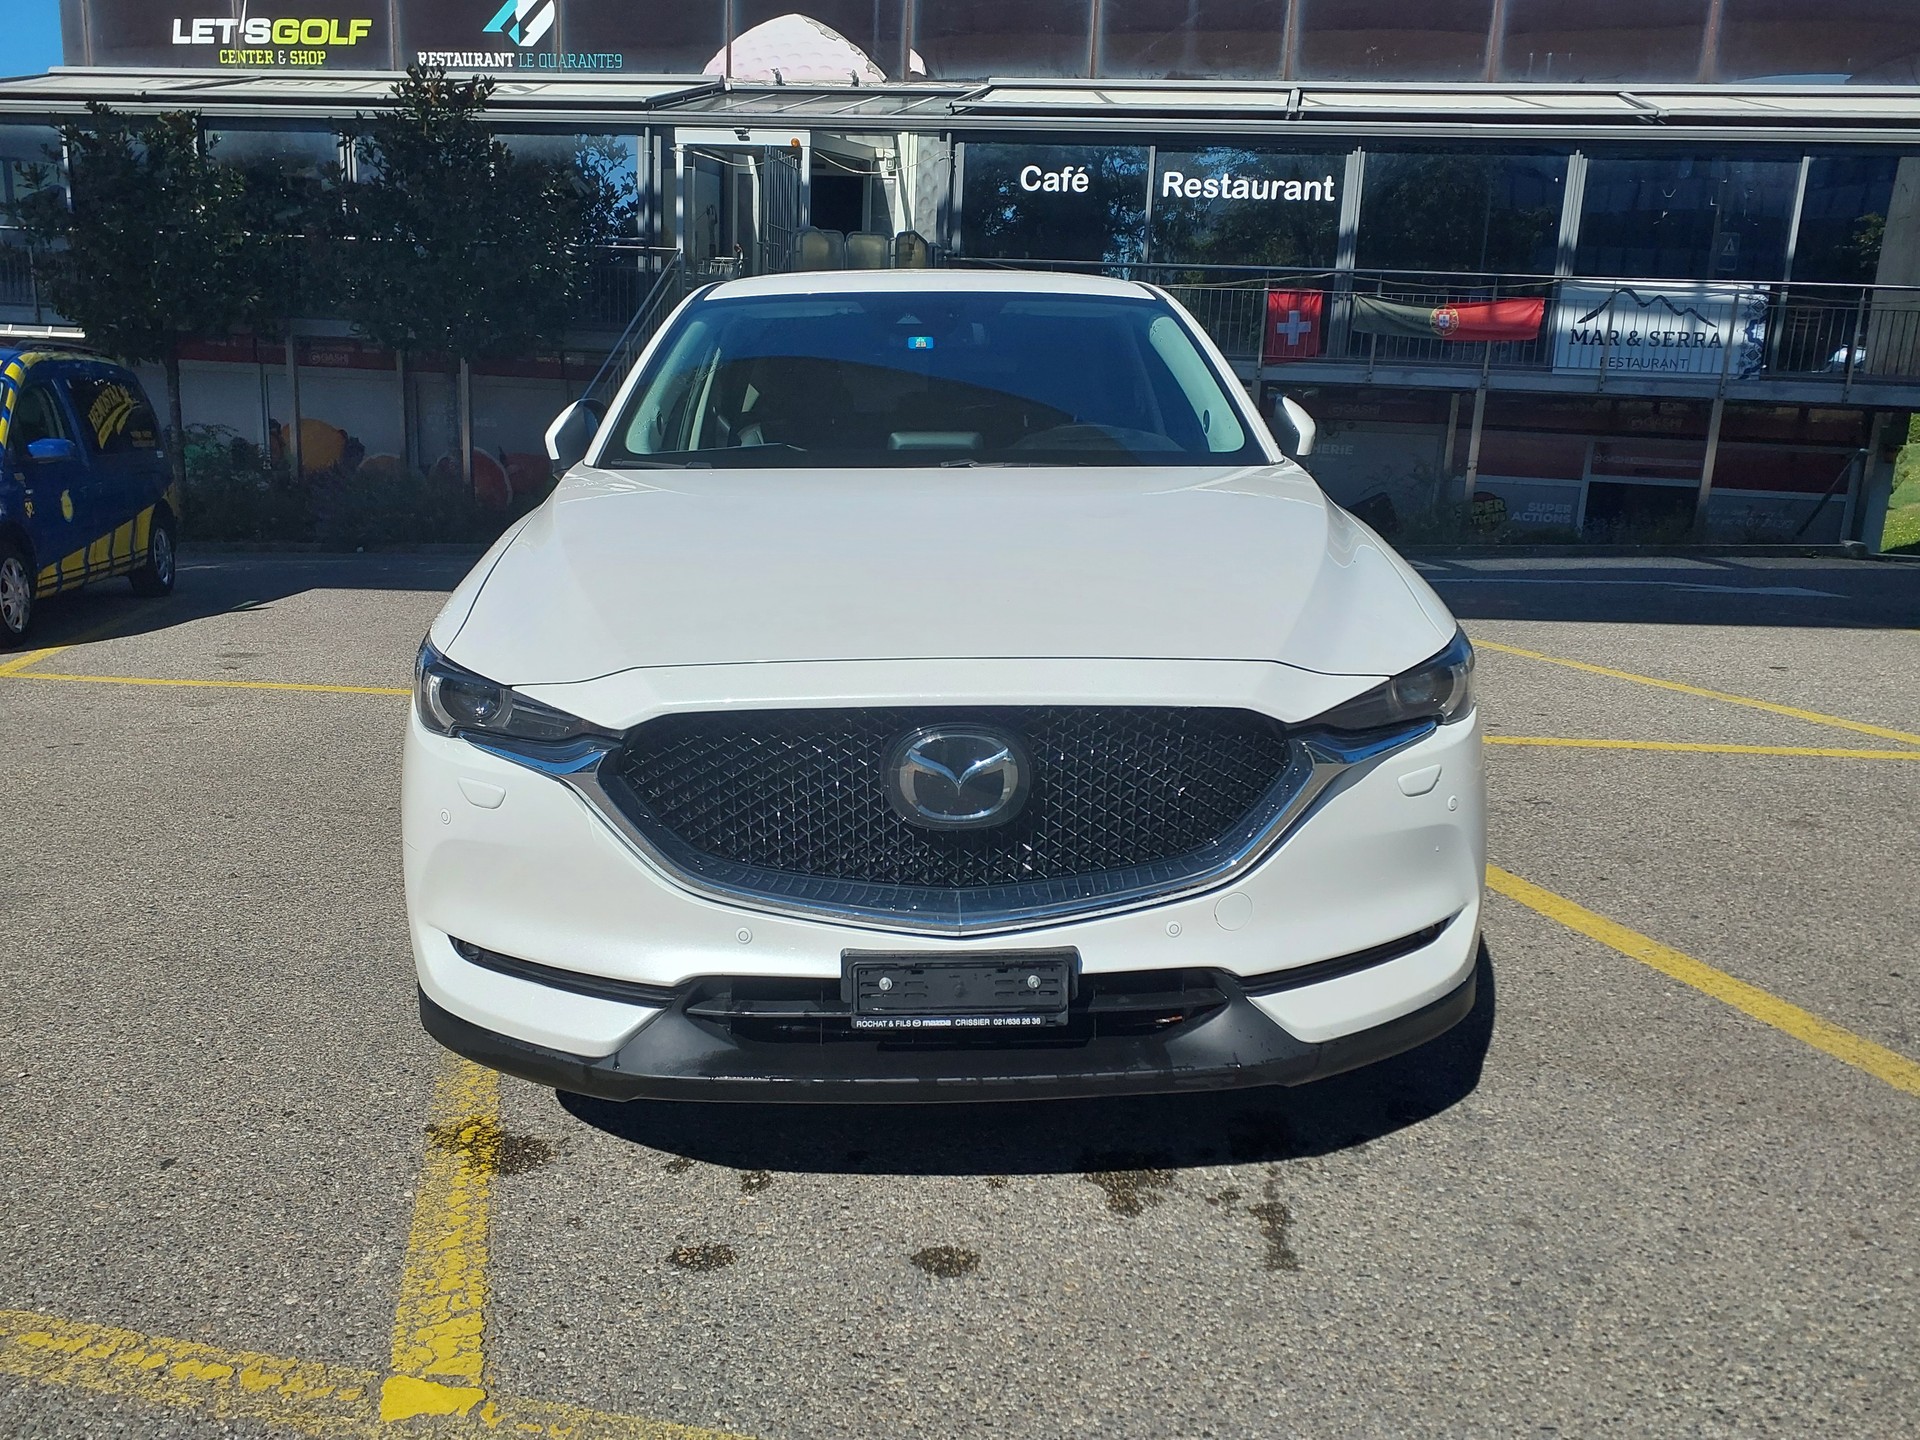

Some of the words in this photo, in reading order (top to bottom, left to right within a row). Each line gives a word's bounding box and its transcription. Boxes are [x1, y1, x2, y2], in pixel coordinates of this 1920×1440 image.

[219, 50, 275, 65] CENTER
[278, 50, 287, 65] &
[290, 50, 326, 65] SHOP
[417, 51, 515, 68] RESTAURANT
[519, 53, 534, 68] LE
[538, 53, 623, 69] QUARANTE9
[1020, 165, 1089, 193] Café
[1162, 171, 1335, 202] Restaurant
[1569, 329, 1620, 346] MAR
[1626, 330, 1641, 347] &
[1648, 331, 1724, 349] SERRA
[1312, 443, 1354, 455] HERIE
[1528, 502, 1572, 513] SUPER
[1511, 512, 1571, 524] ACTIONS
[856, 1020, 887, 1028] ROCHAT
[955, 1019, 990, 1027] CRISSIER
